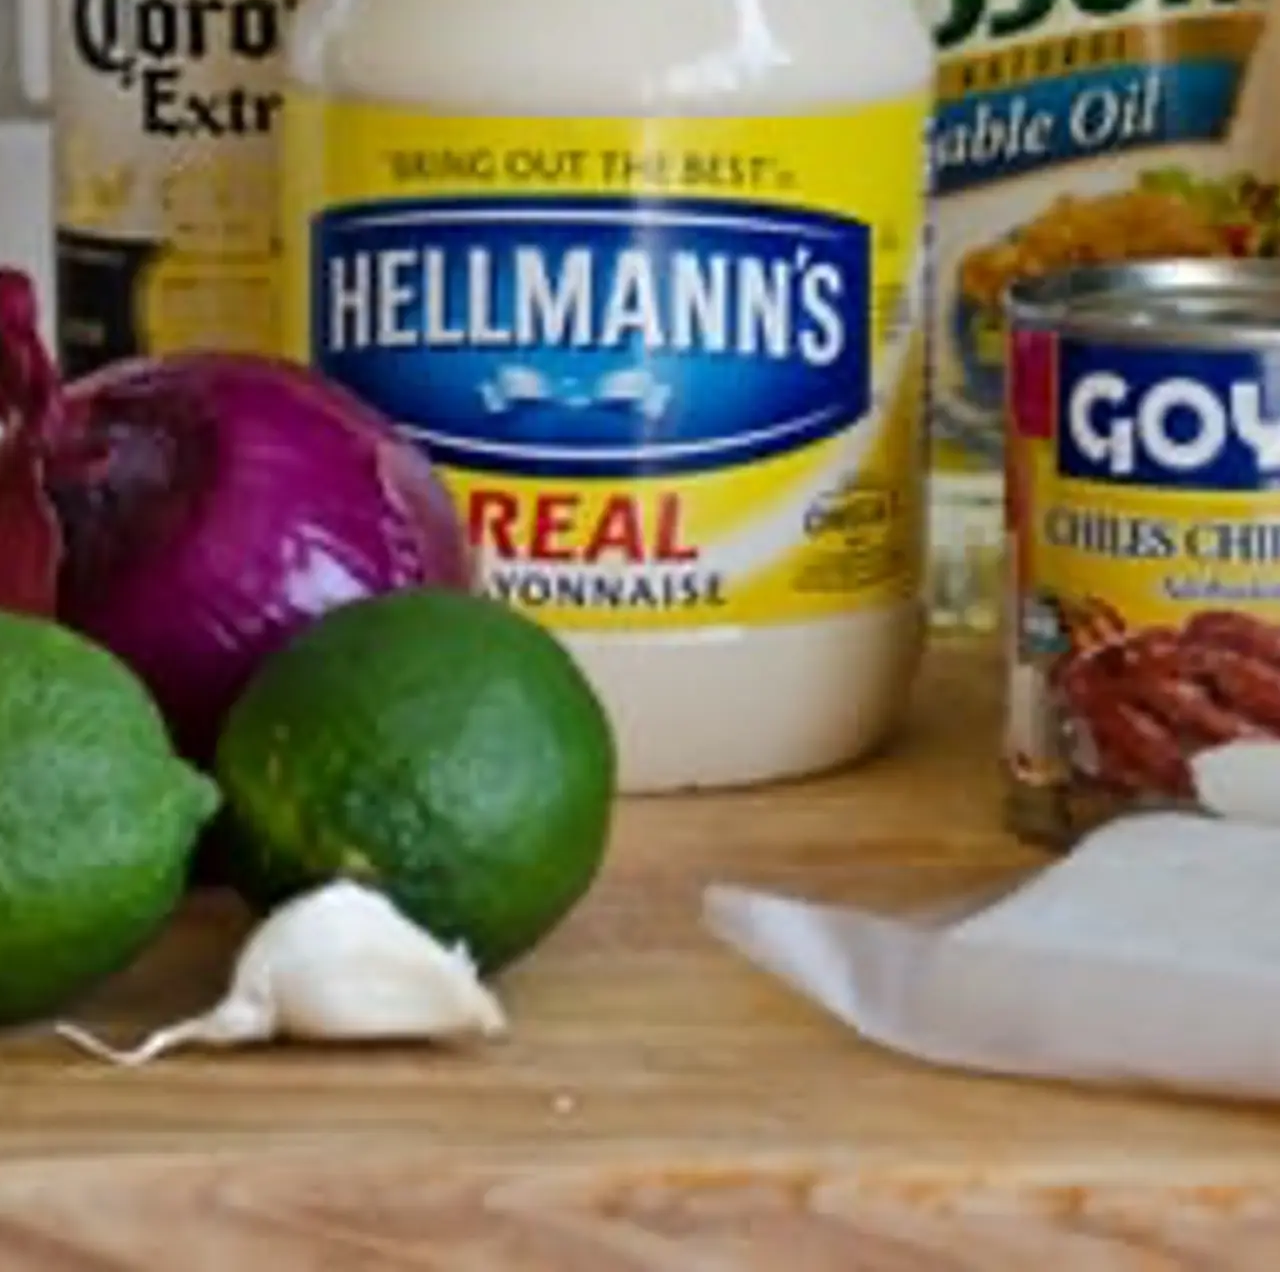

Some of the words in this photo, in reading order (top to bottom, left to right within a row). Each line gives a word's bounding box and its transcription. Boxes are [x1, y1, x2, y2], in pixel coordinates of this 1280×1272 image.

[141, 69, 283, 137] Extr
[1070, 73, 1161, 146] Oil
[505, 150, 586, 182] OUT
[327, 243, 846, 366] HELLMANN'S
[467, 489, 700, 564] REAL
[1043, 505, 1175, 560] CHILES
[482, 571, 729, 609] YONNAISE
